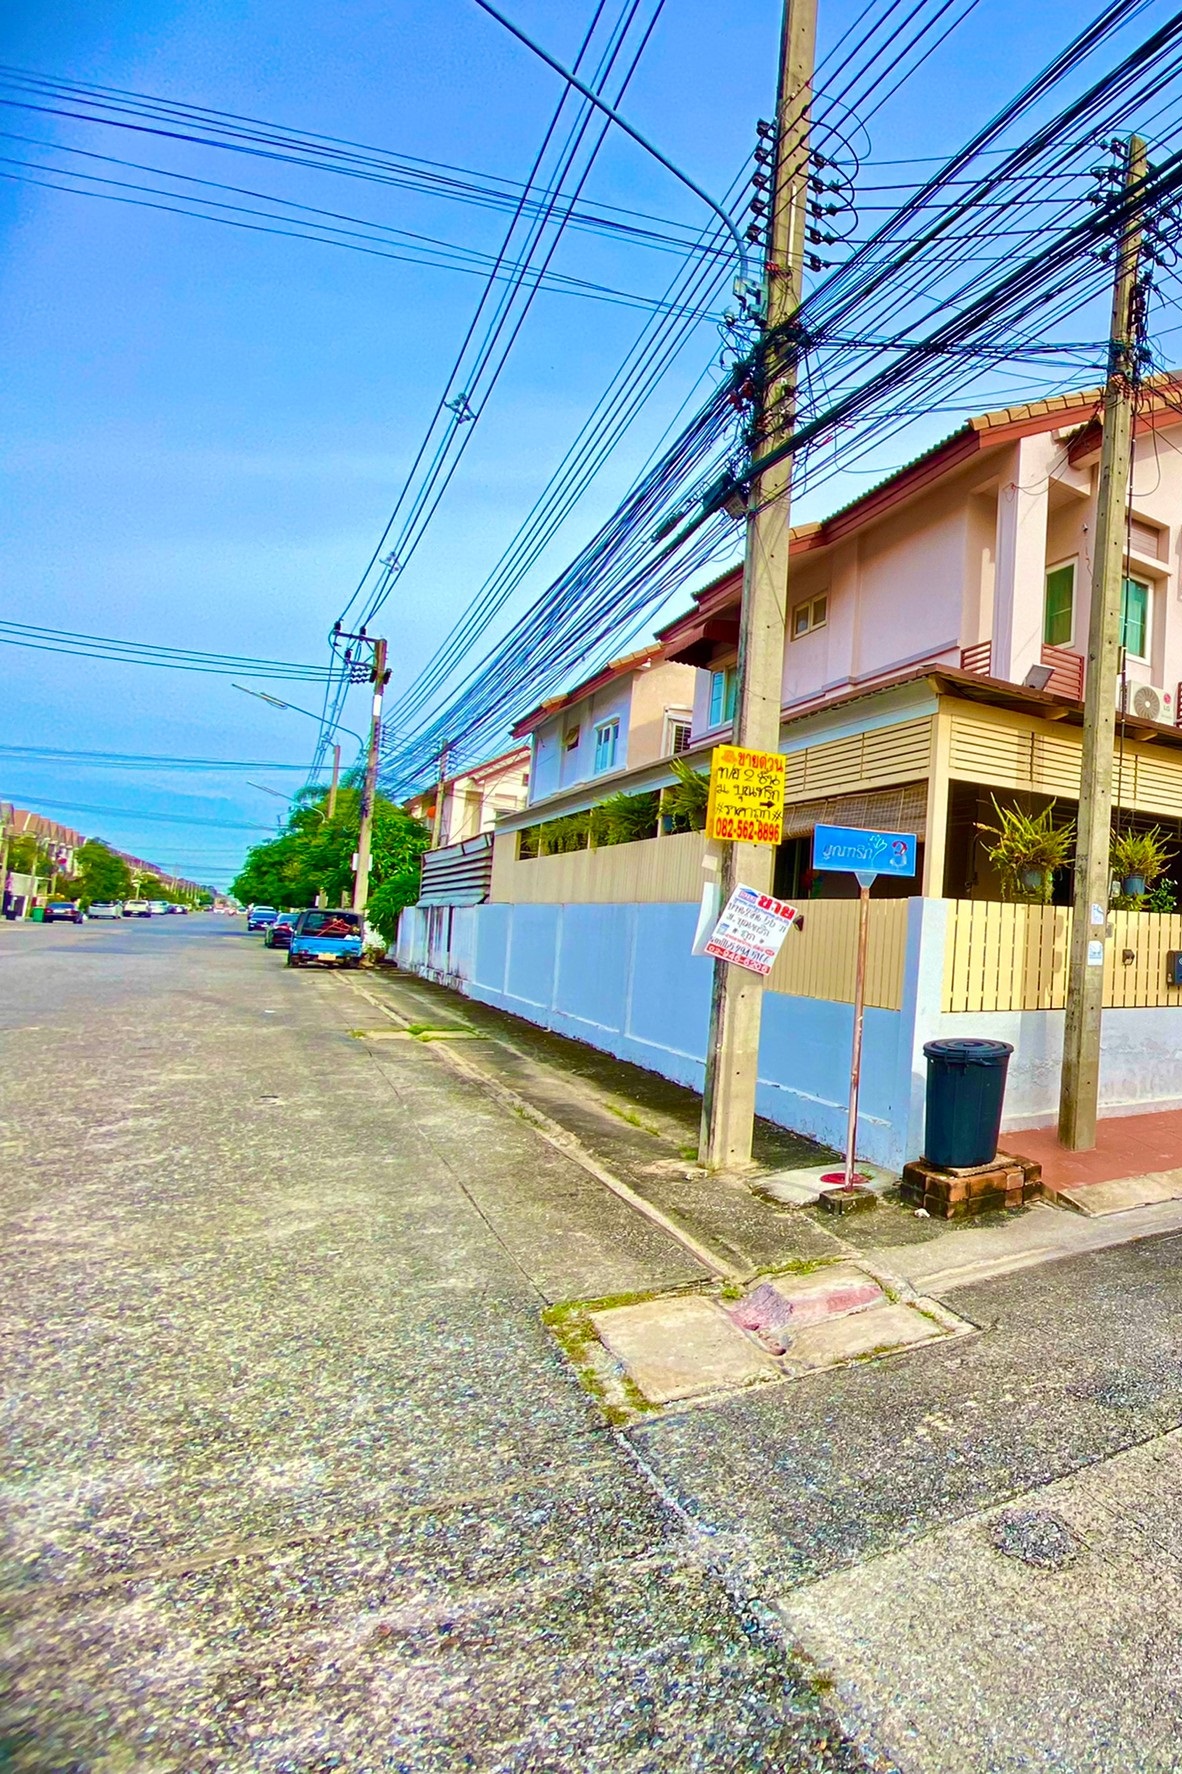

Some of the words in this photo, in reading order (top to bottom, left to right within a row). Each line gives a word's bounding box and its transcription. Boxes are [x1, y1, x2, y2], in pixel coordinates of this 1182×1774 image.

[738, 752, 784, 772] ขายด่วน
[744, 769, 755, 781] 2
[757, 894, 796, 920] ขาย
